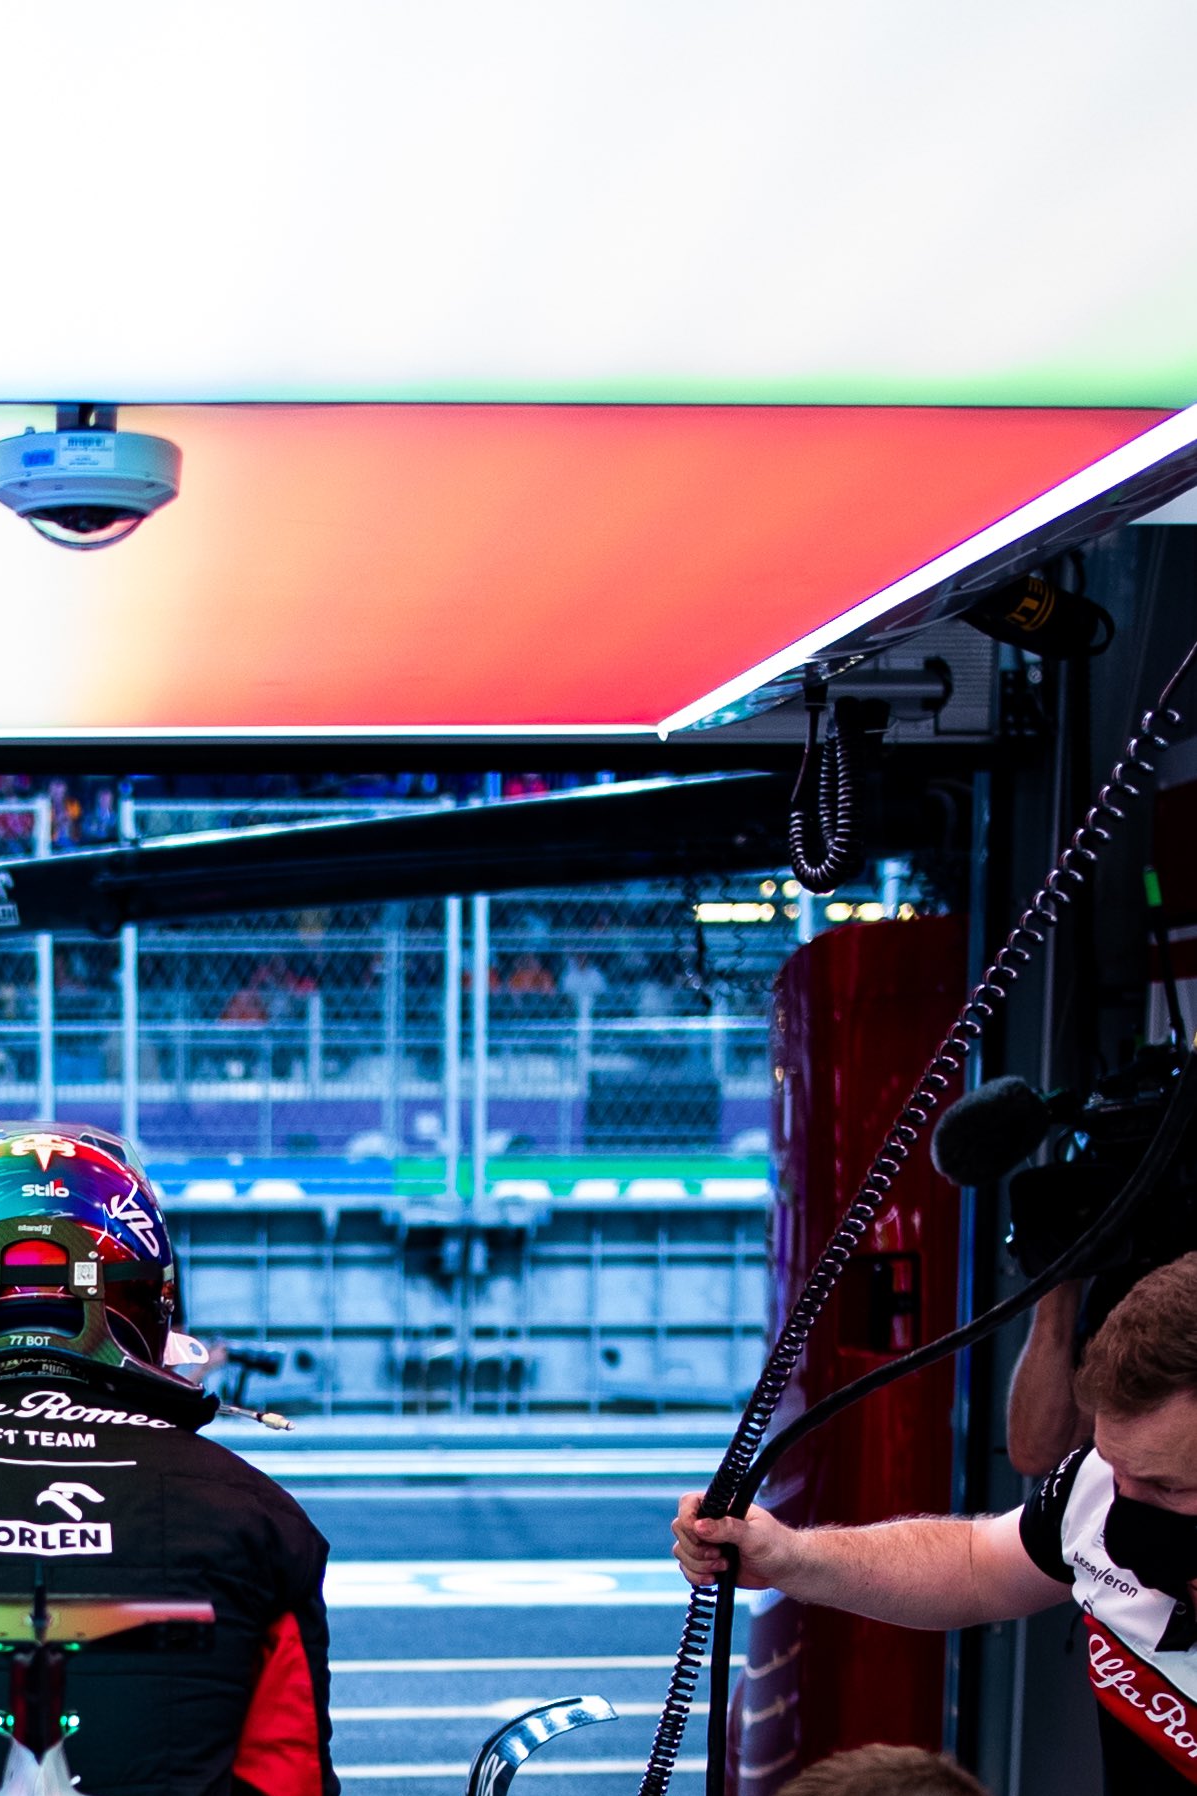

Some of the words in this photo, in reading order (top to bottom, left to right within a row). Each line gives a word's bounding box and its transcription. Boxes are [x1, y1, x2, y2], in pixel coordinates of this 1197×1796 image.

[9, 1335, 24, 1346] 77
[26, 1336, 51, 1346] BOT
[14, 1390, 177, 1429] Romeo
[24, 1429, 96, 1448] TEAM
[1088, 1633, 1146, 1709] Alfa
